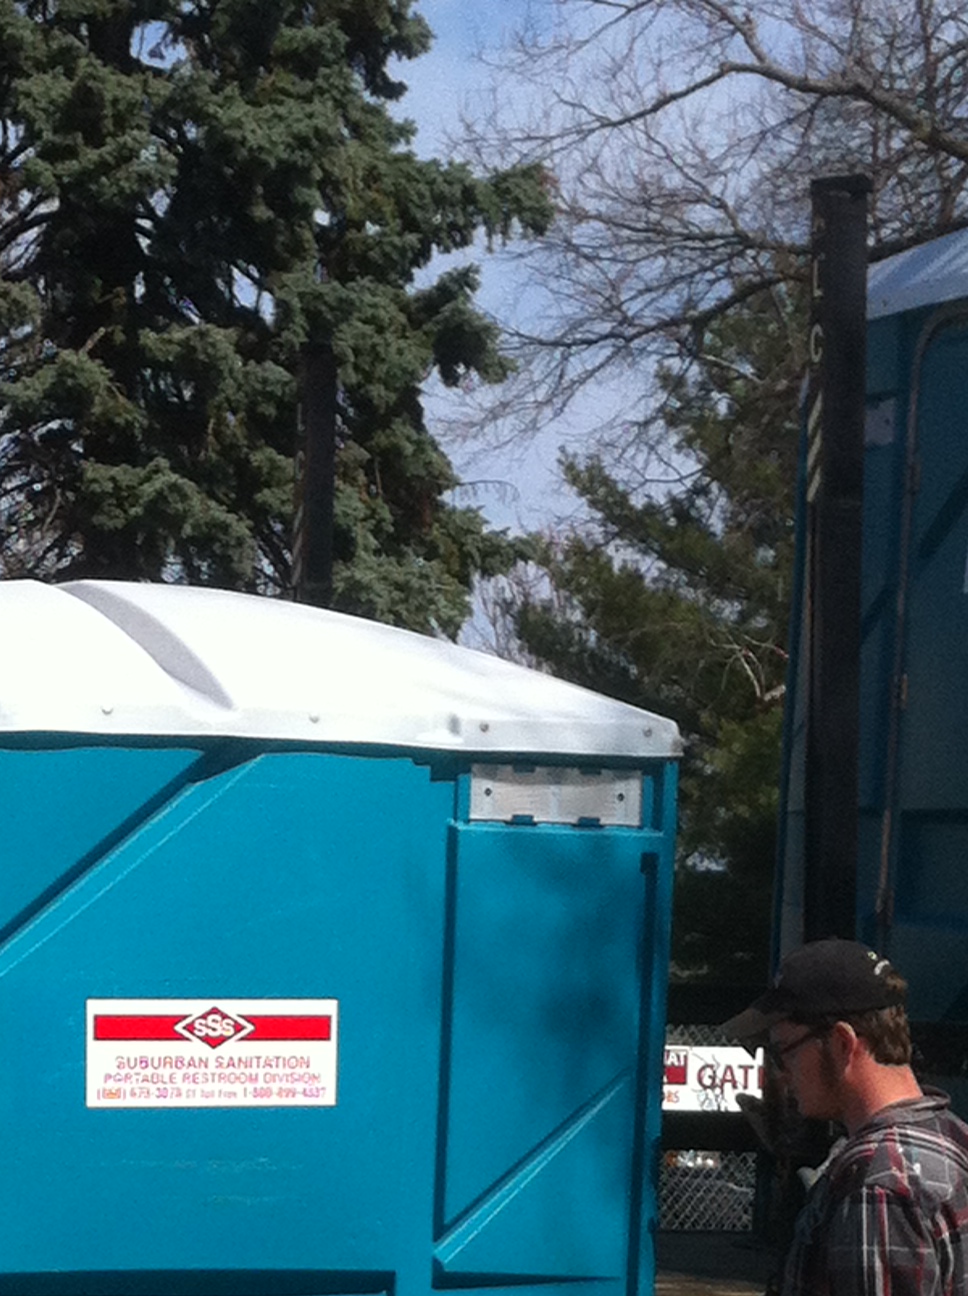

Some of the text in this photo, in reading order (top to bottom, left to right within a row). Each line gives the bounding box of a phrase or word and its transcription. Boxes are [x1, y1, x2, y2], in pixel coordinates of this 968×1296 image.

[193, 1014, 235, 1037] SSS
[115, 1055, 311, 1069] SUBURBAN SANITATION
[665, 1052, 687, 1066] AT
[103, 1072, 321, 1084] PORTABLE RESTROOM DIVISION
